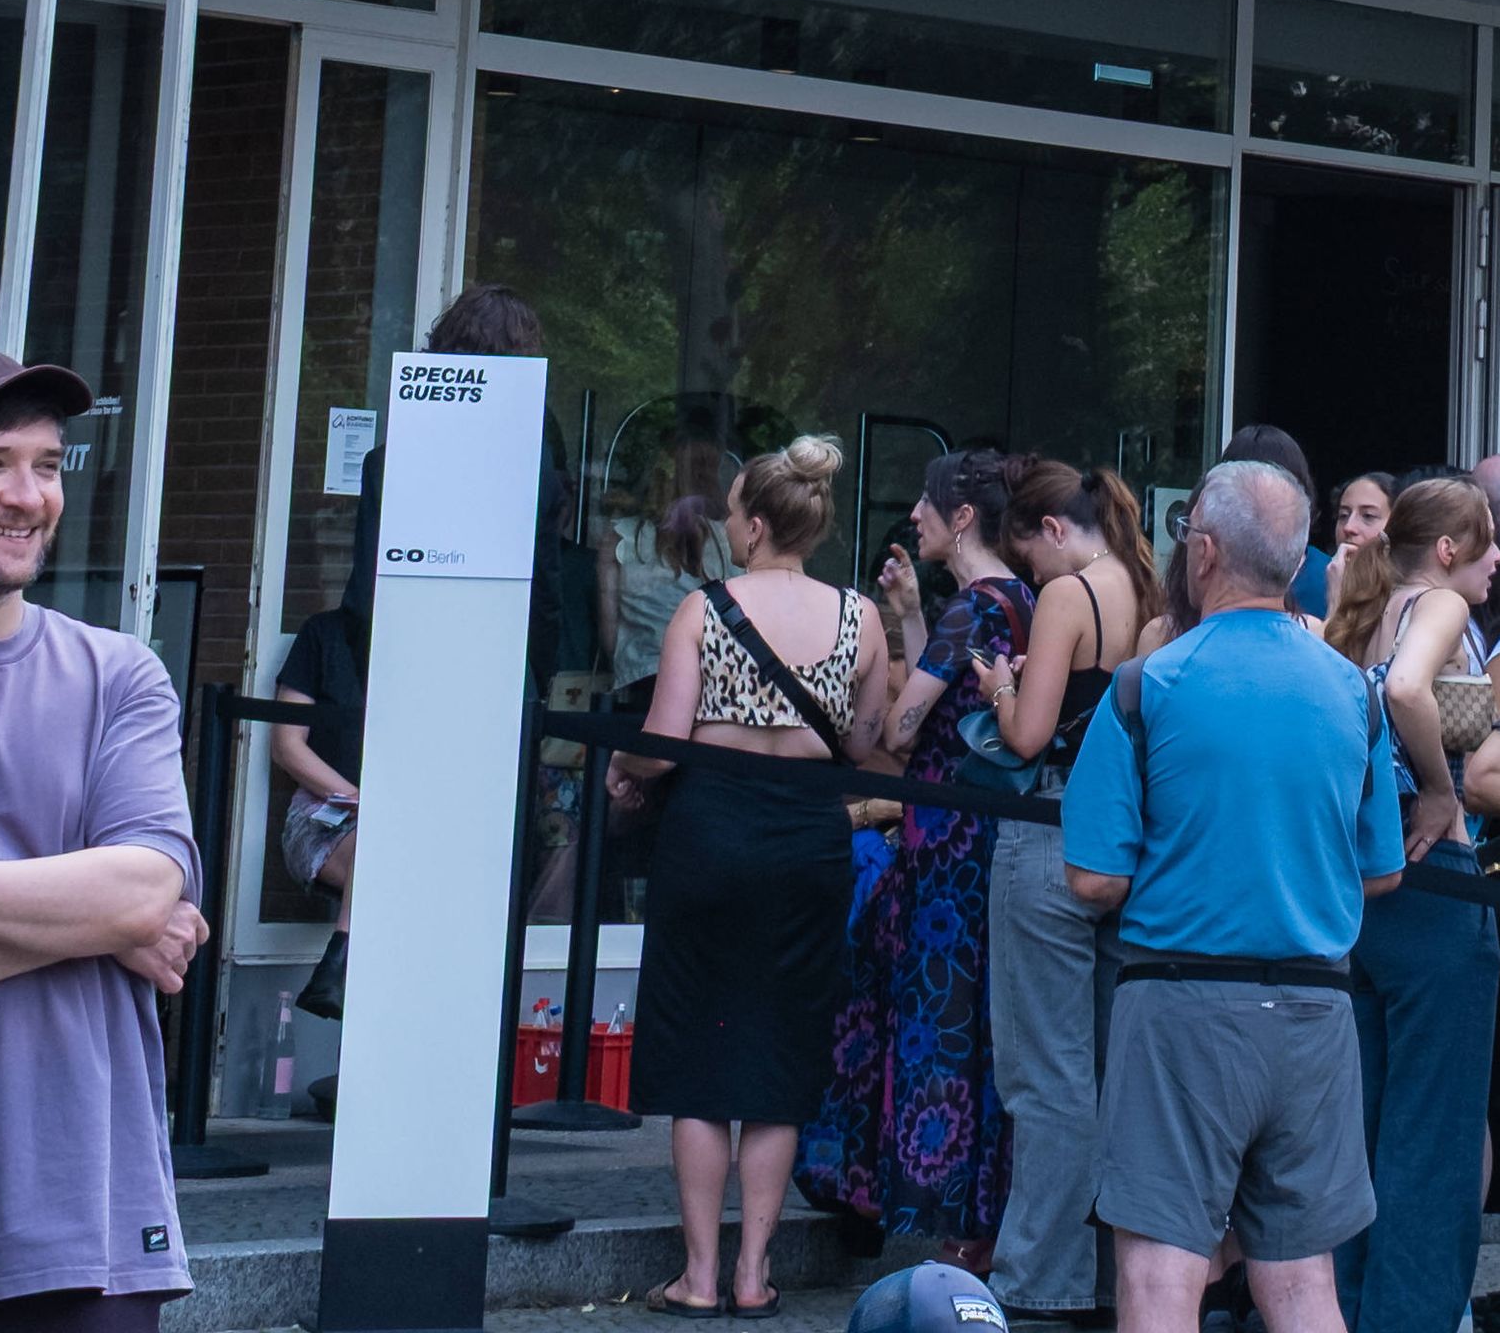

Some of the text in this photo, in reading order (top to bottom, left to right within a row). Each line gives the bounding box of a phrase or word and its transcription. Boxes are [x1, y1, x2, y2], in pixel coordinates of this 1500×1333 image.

[399, 365, 488, 385] SPECIAL
[399, 385, 483, 403] GUESTS
[427, 549, 465, 564] Berlin
